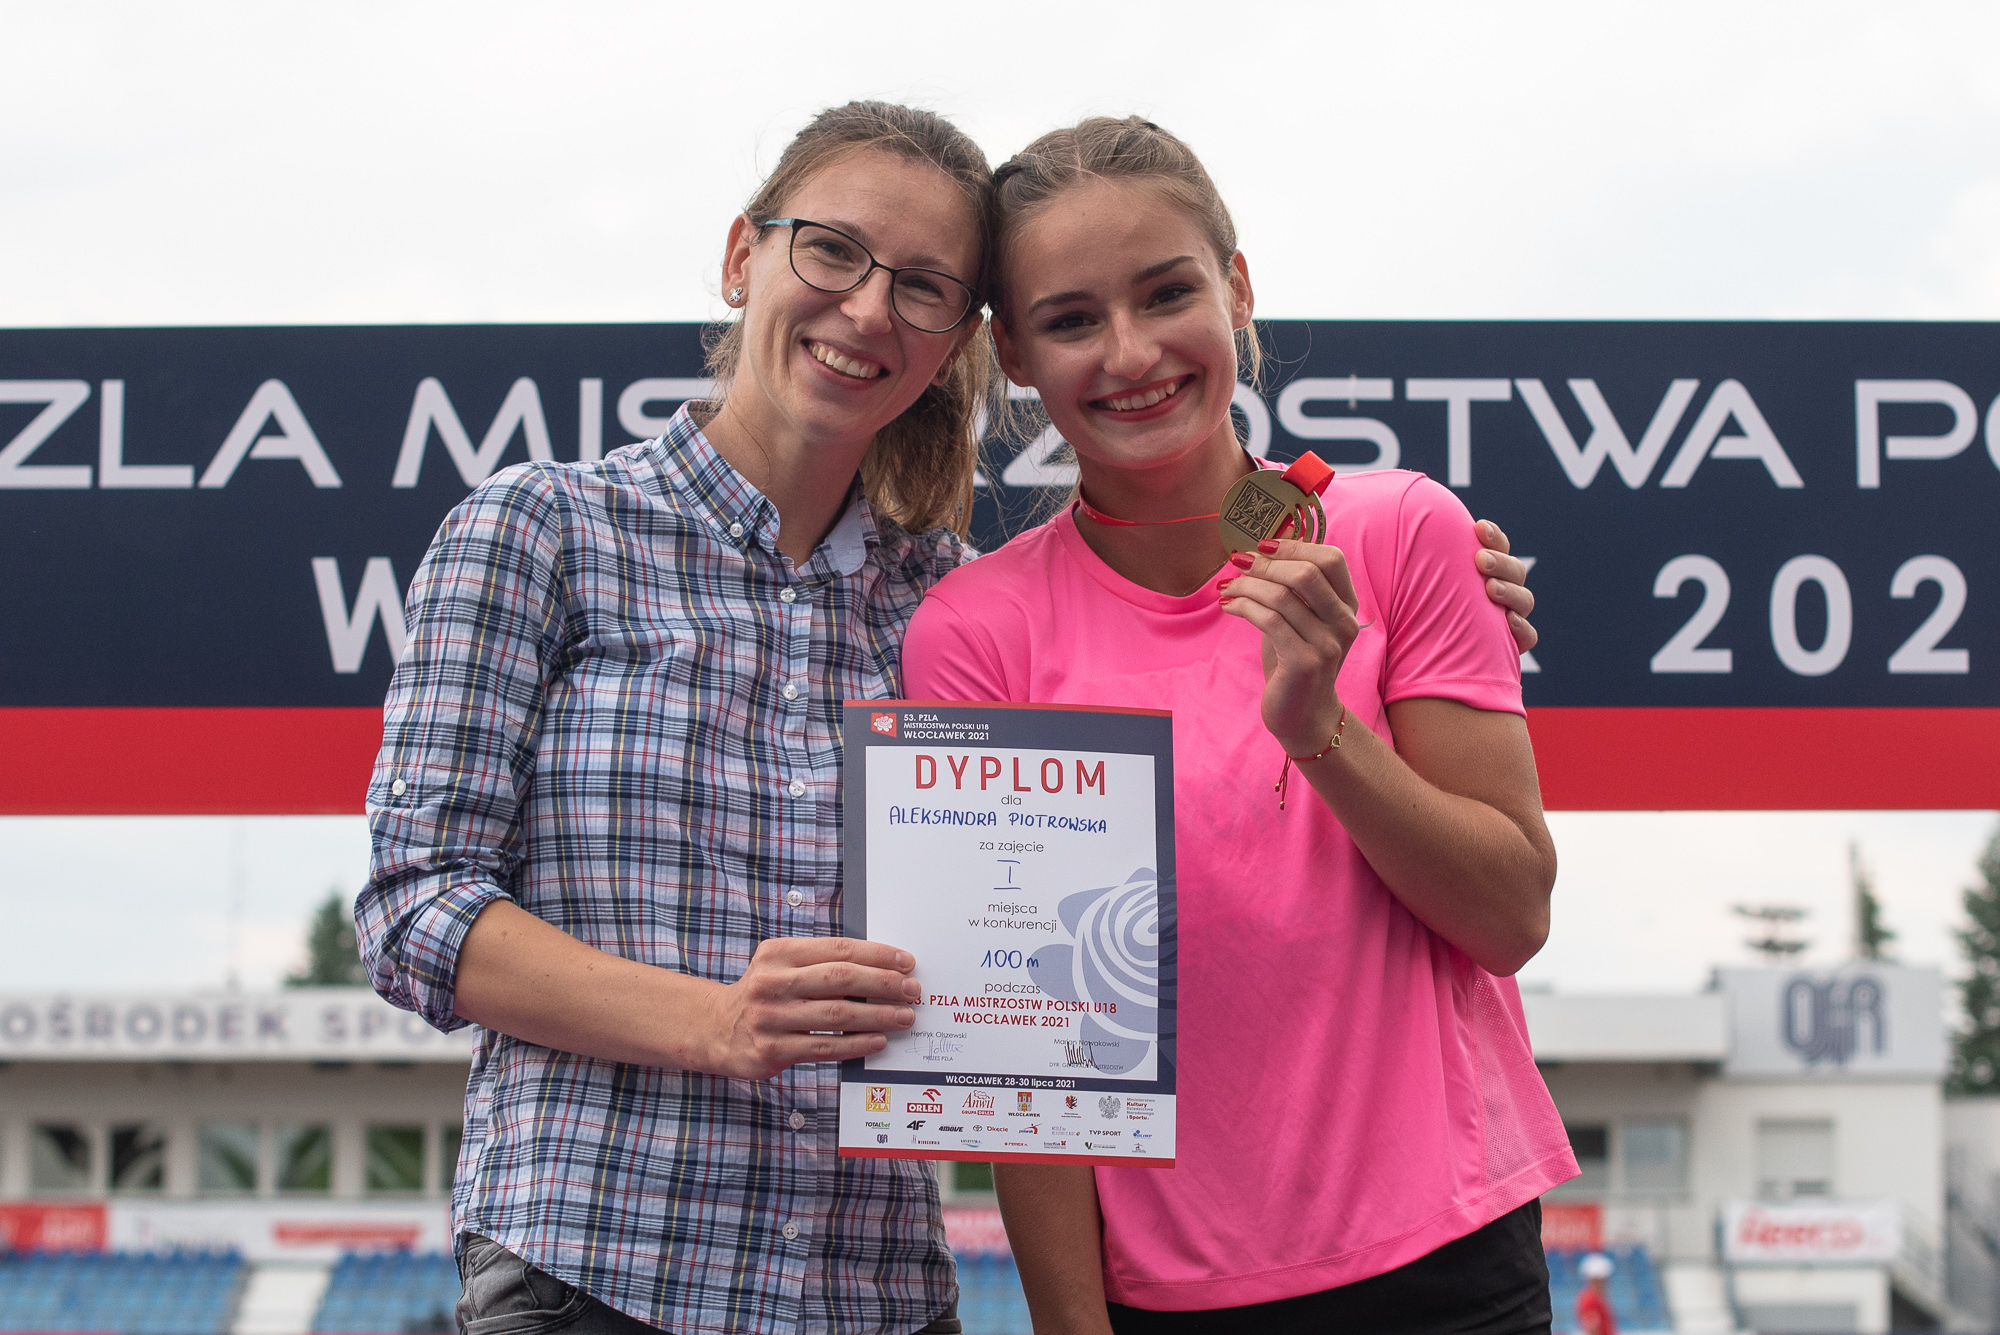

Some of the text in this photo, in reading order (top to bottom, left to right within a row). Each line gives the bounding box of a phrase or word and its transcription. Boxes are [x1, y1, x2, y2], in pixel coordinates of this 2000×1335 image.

[1855, 379, 2000, 489] P
[904, 730, 989, 740] WŁOCŁAWEK 2021
[915, 754, 1105, 796] DYPLOM
[1001, 795, 1021, 806] dla
[889, 806, 1107, 834] ALEKSANDRA PIOTROWSKA
[979, 841, 1044, 853] za zajęcie
[988, 902, 1038, 916] miejsca
[968, 917, 1057, 933] w konkurencji
[980, 949, 1039, 969] 100 m
[984, 982, 1041, 994] podczas
[906, 995, 1117, 1014] 3. PZLA MISTRZOSTW POLSKI U18
[953, 1012, 1070, 1028] WŁOCŁAWEK 2021
[946, 1075, 1075, 1088] WŁOCŁAWEK 28-30 lipca 2021
[962, 1092, 995, 1108] Anwil
[909, 1104, 941, 1113] ORLEN
[906, 1120, 926, 1130] 4F
